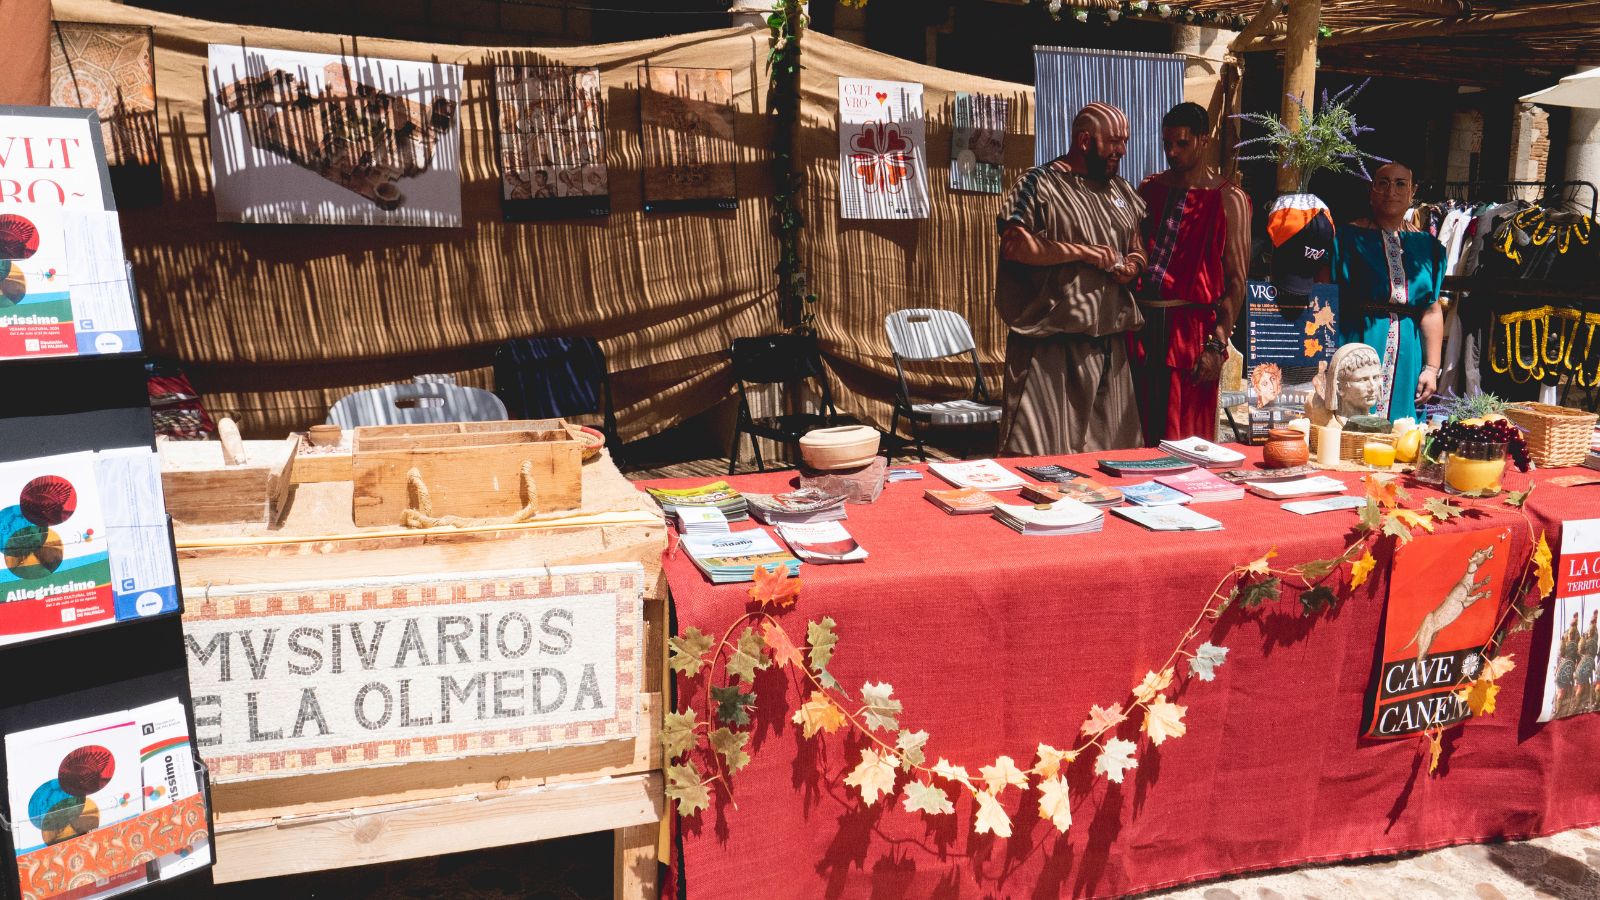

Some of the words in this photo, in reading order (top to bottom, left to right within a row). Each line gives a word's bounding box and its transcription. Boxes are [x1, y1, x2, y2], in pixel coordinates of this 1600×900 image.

[1250, 284, 1277, 301] VRO
[1569, 558, 1589, 577] LA
[6, 580, 96, 602] Allegrissimo
[64, 592, 86, 600] CULTURAL
[183, 608, 574, 681] MVSIVARIOS
[1385, 656, 1454, 693] CAVE
[244, 686, 335, 742] LA
[354, 663, 605, 731] OLMEDA
[1379, 696, 1471, 734] CANEM
